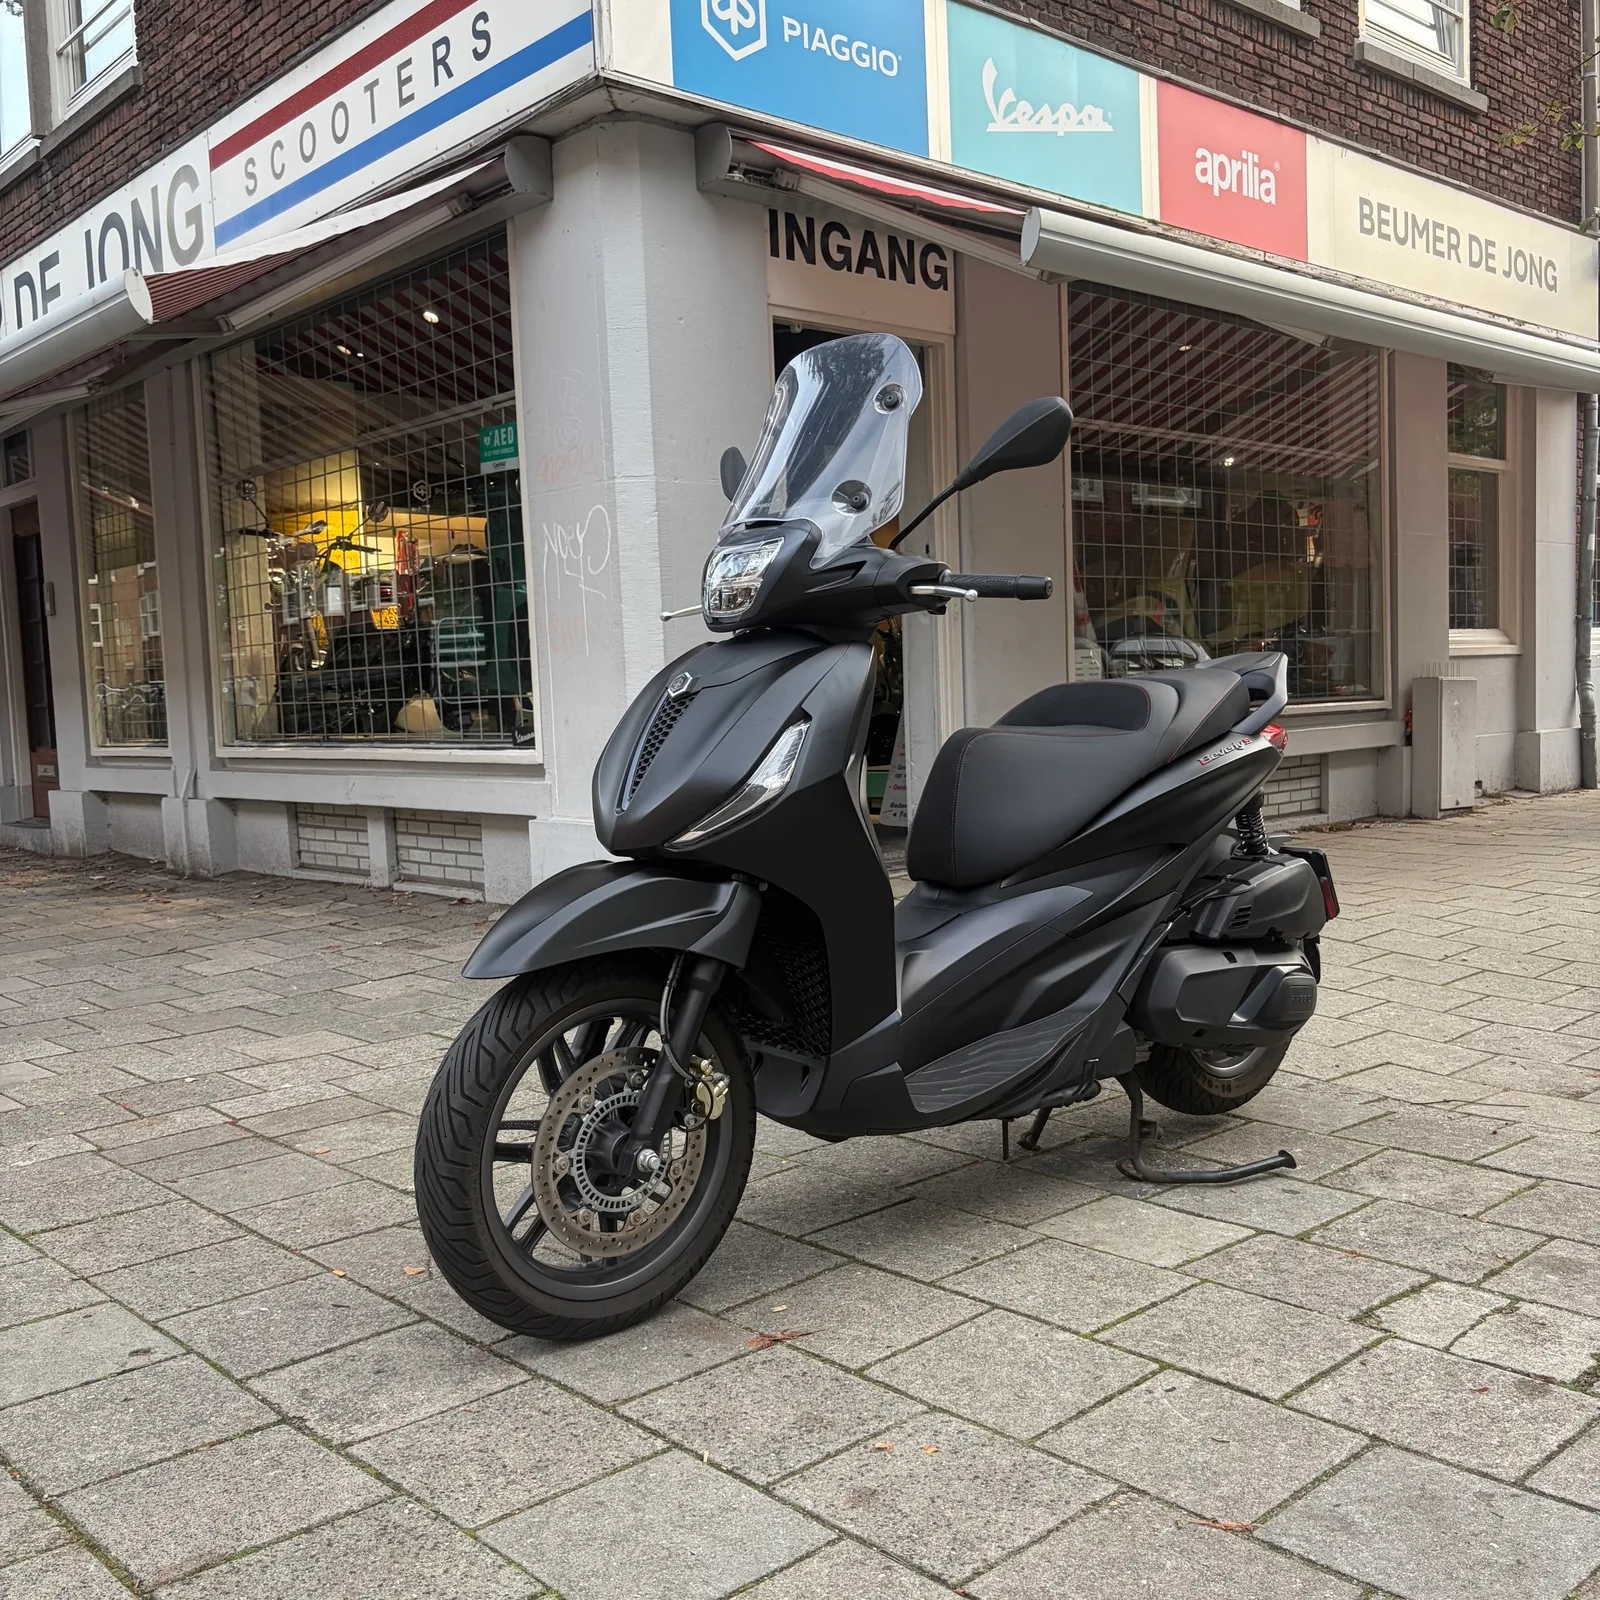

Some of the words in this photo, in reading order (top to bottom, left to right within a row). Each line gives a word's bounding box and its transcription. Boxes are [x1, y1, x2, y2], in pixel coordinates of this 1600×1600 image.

[782, 15, 899, 77] PIAGGIO
[244, 11, 491, 196] SCOOTERS
[982, 57, 1113, 136] Vespa
[1195, 147, 1276, 205] aprilia
[768, 208, 948, 291] INGANG
[1358, 196, 1462, 264] BEUMER
[1468, 233, 1497, 275] DE
[1502, 245, 1558, 293] JONG
[494, 426, 514, 447] AED
